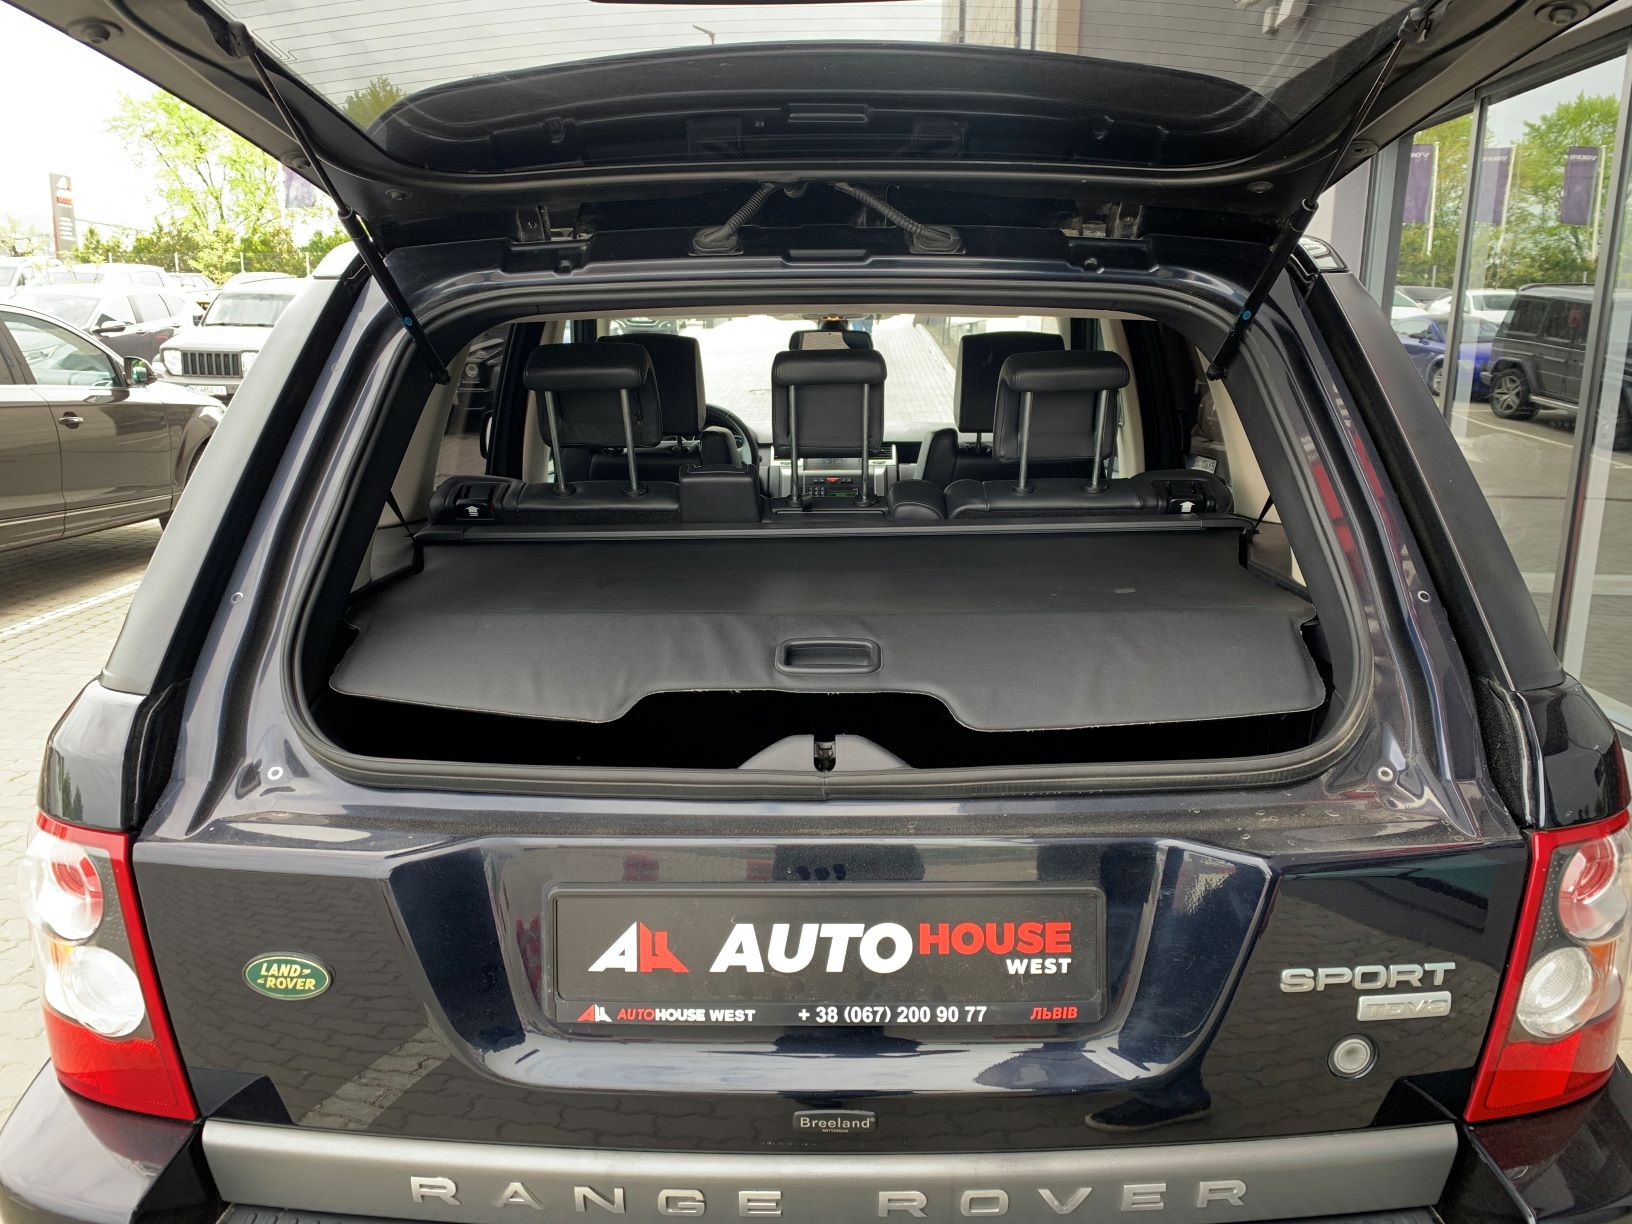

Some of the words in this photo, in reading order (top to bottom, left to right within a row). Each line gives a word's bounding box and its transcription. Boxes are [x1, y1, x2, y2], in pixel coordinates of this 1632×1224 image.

[919, 922, 1072, 955] HOUSE
[709, 922, 914, 974] AUTO
[260, 963, 301, 977] LAND
[1006, 958, 1072, 975] WEST
[265, 976, 316, 990] ROVER
[1280, 962, 1456, 993] SPORT
[617, 1008, 705, 1022] AUTOHOUSE
[710, 1009, 755, 1021] WEST
[816, 1007, 838, 1023] 38
[844, 1006, 892, 1023] (067)
[896, 1006, 931, 1023] 200
[936, 1006, 959, 1022] 90
[965, 1006, 988, 1022] 77
[800, 1117, 870, 1128] Breeland
[410, 1176, 784, 1217] RANGE
[878, 1180, 1247, 1218] ROVER
